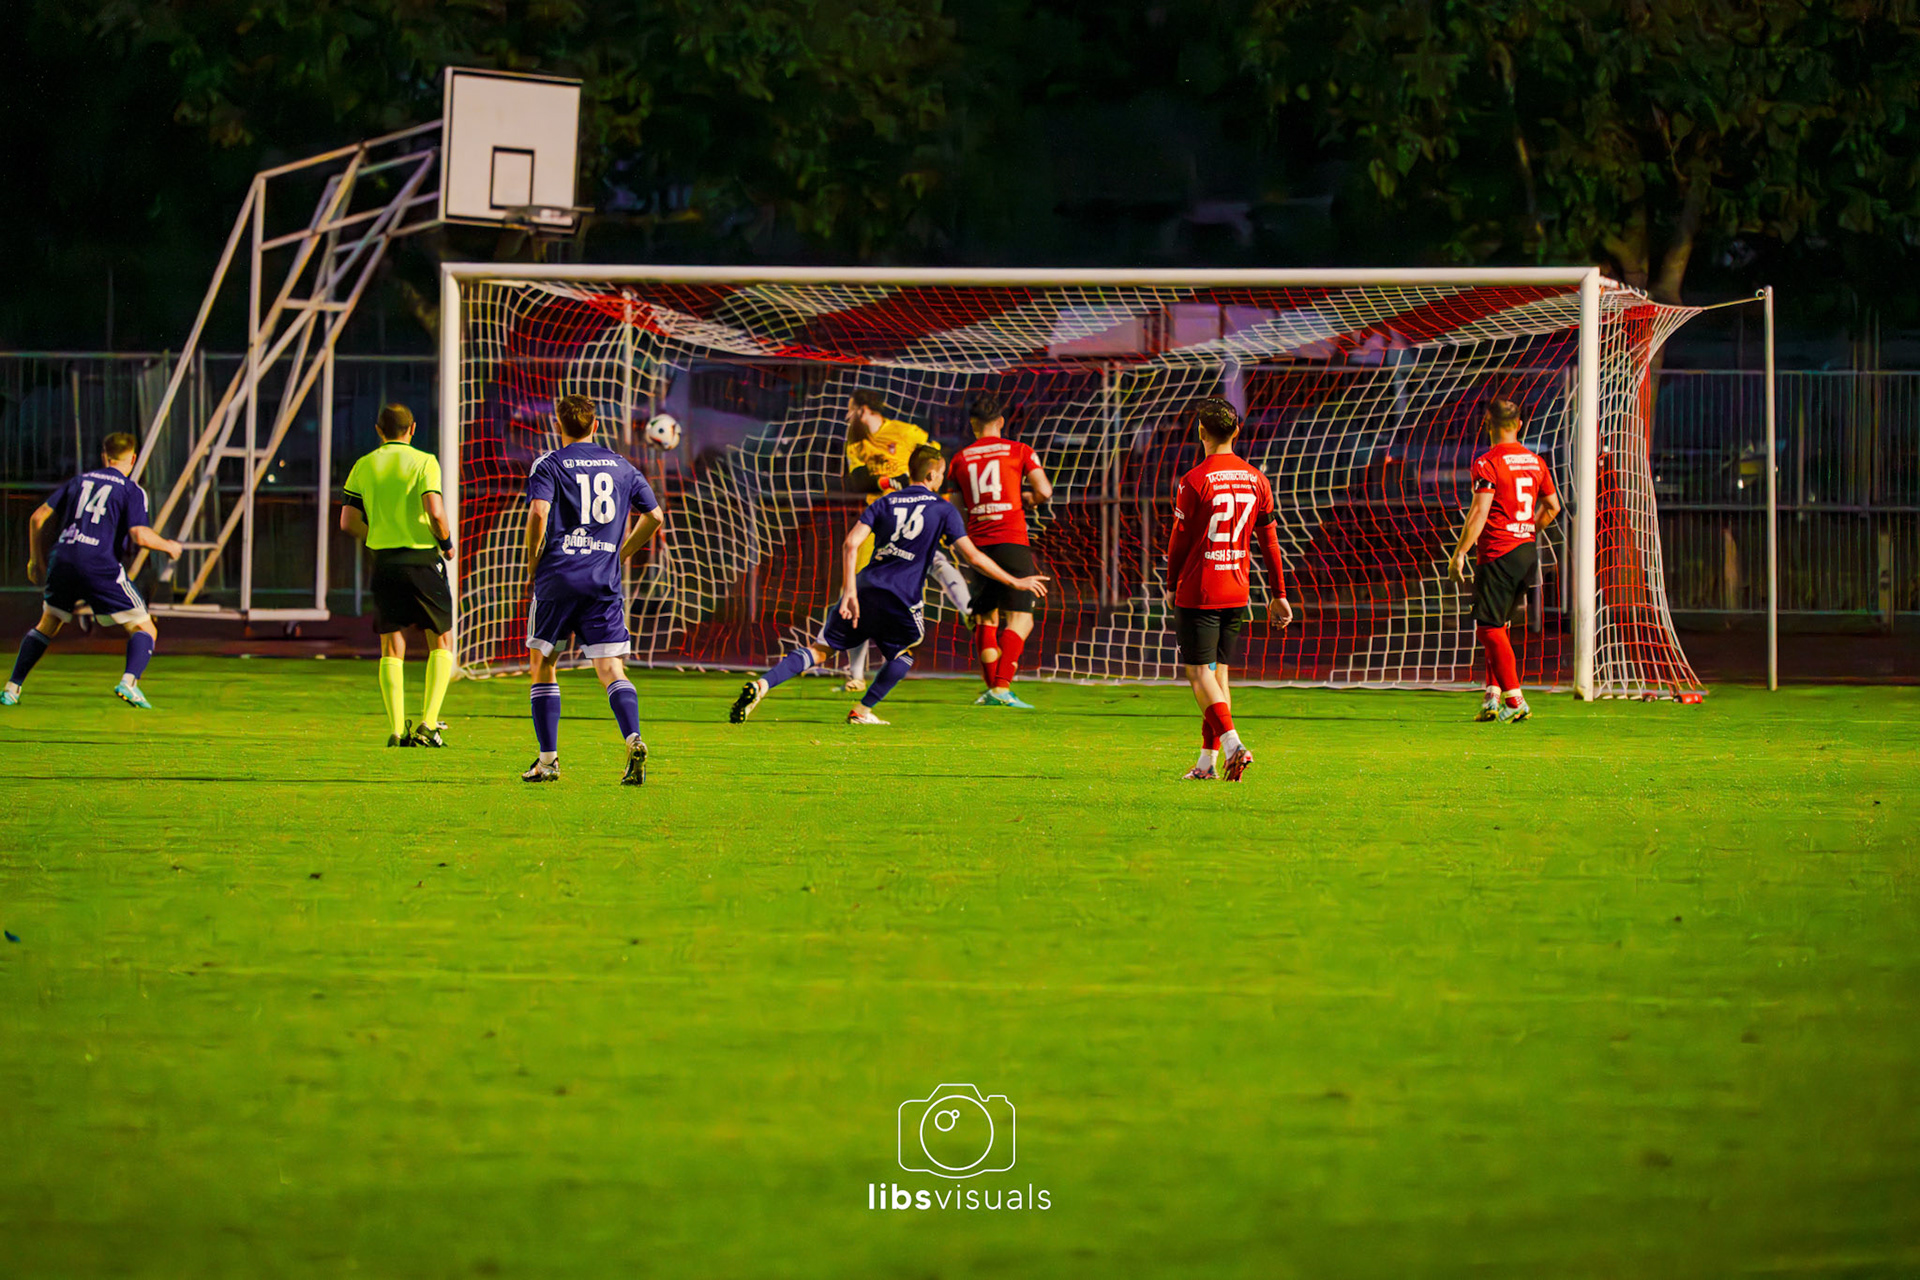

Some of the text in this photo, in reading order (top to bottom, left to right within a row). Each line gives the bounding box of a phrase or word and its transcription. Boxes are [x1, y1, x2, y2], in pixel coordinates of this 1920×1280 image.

[575, 459, 618, 467] HONDA
[967, 459, 1003, 505] 14
[74, 480, 113, 525] 14
[575, 472, 616, 525] 18
[1207, 493, 1257, 543] 27
[1515, 477, 1534, 522] 5
[890, 504, 926, 542] 16
